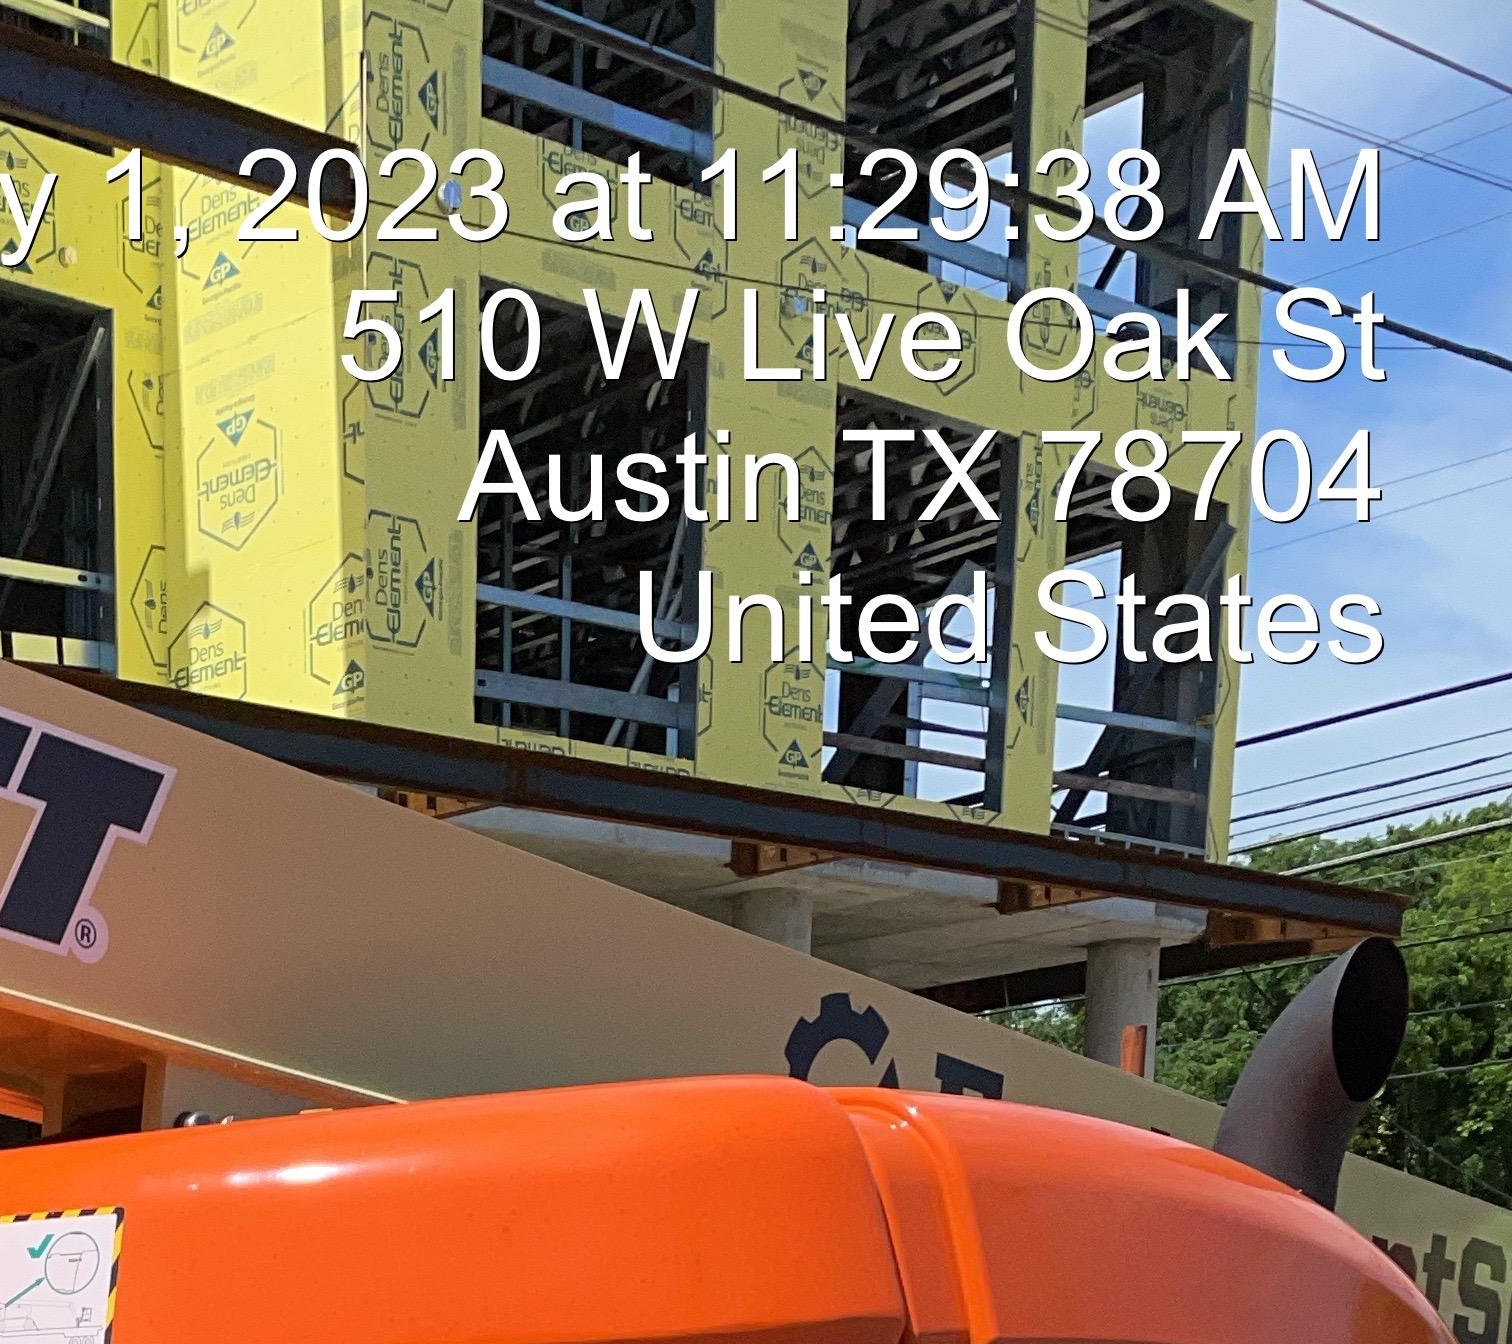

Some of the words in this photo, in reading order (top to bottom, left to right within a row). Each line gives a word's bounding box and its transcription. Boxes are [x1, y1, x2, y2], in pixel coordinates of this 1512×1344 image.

[388, 19, 404, 150] Element
[201, 188, 238, 215] Dens
[209, 260, 233, 284] GP
[198, 457, 278, 502] Element
[220, 484, 256, 511] Dens
[376, 548, 389, 605] Dens
[387, 516, 402, 643] Element
[422, 570, 433, 604] GP
[332, 599, 364, 624] Den
[188, 641, 226, 666] Dens
[341, 670, 364, 691] GP
